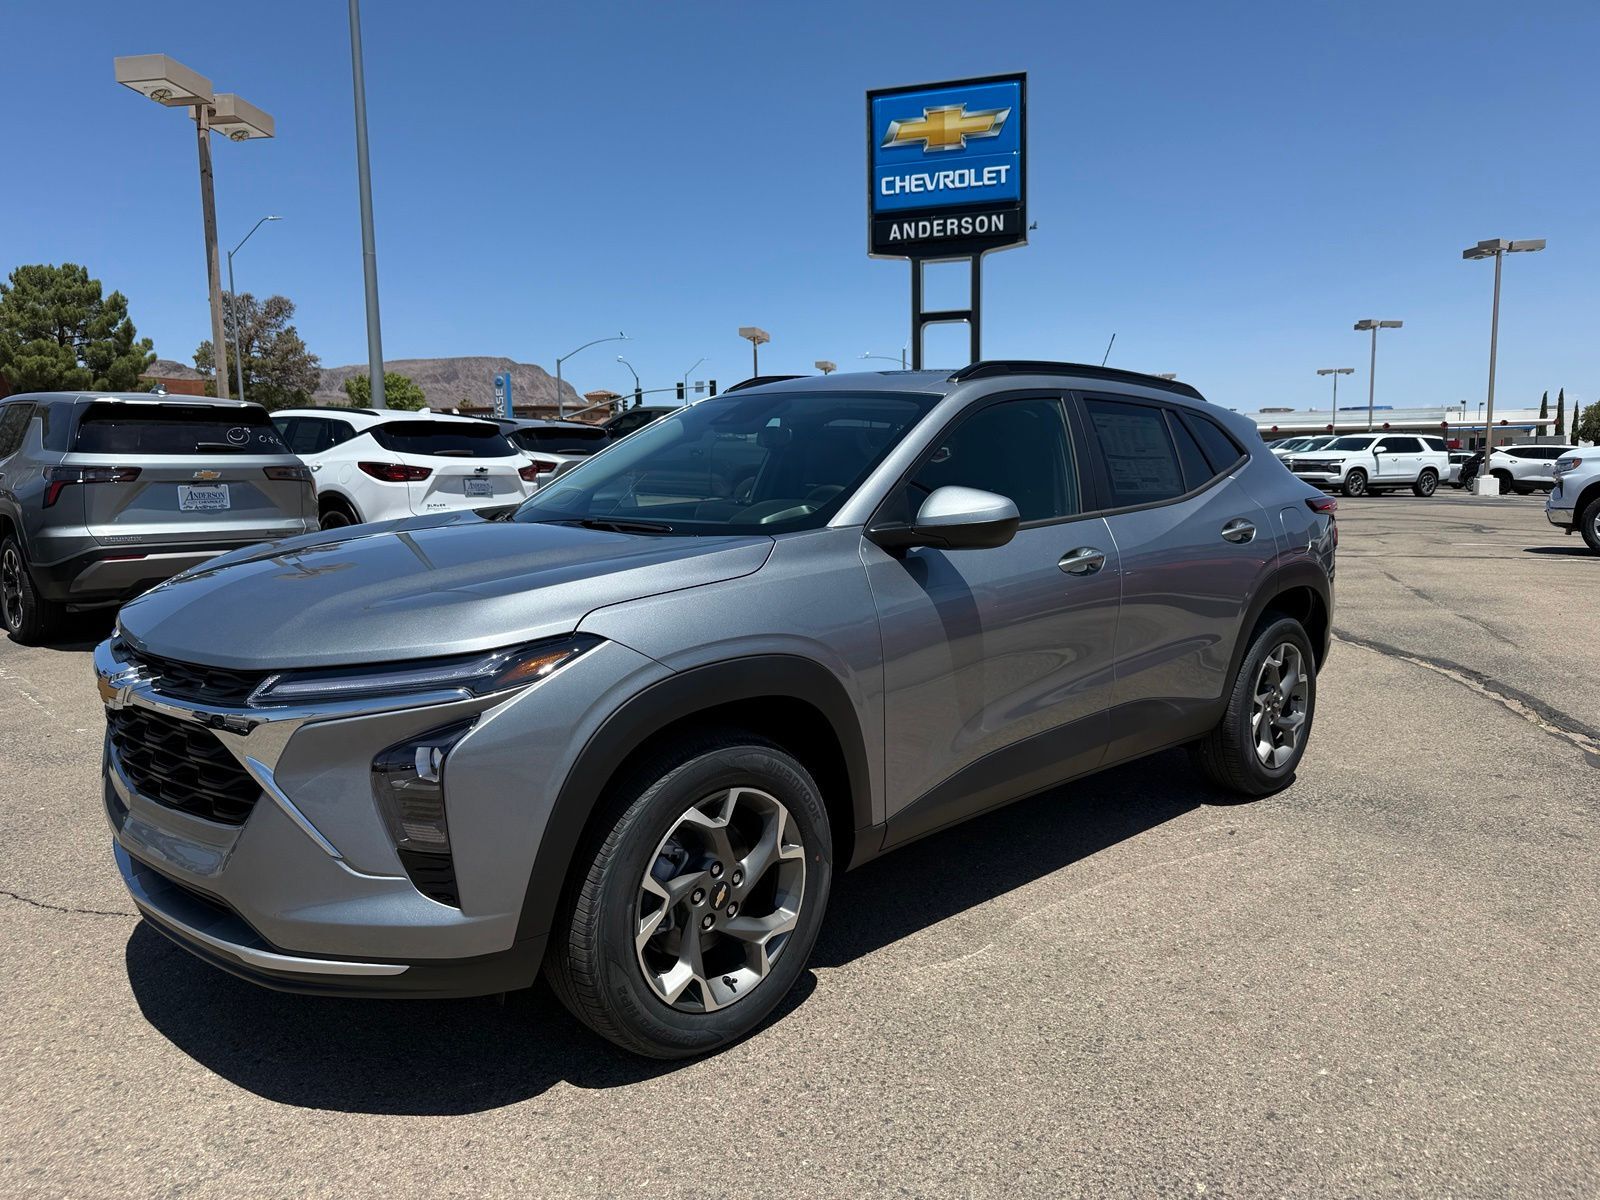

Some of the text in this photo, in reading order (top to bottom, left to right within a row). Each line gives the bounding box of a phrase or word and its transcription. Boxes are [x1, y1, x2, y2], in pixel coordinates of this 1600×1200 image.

[881, 165, 1010, 196] CHEVROLET
[889, 214, 1004, 240] ANDERSON
[495, 388, 505, 419] HASE
[184, 490, 225, 505] ANDERSON
